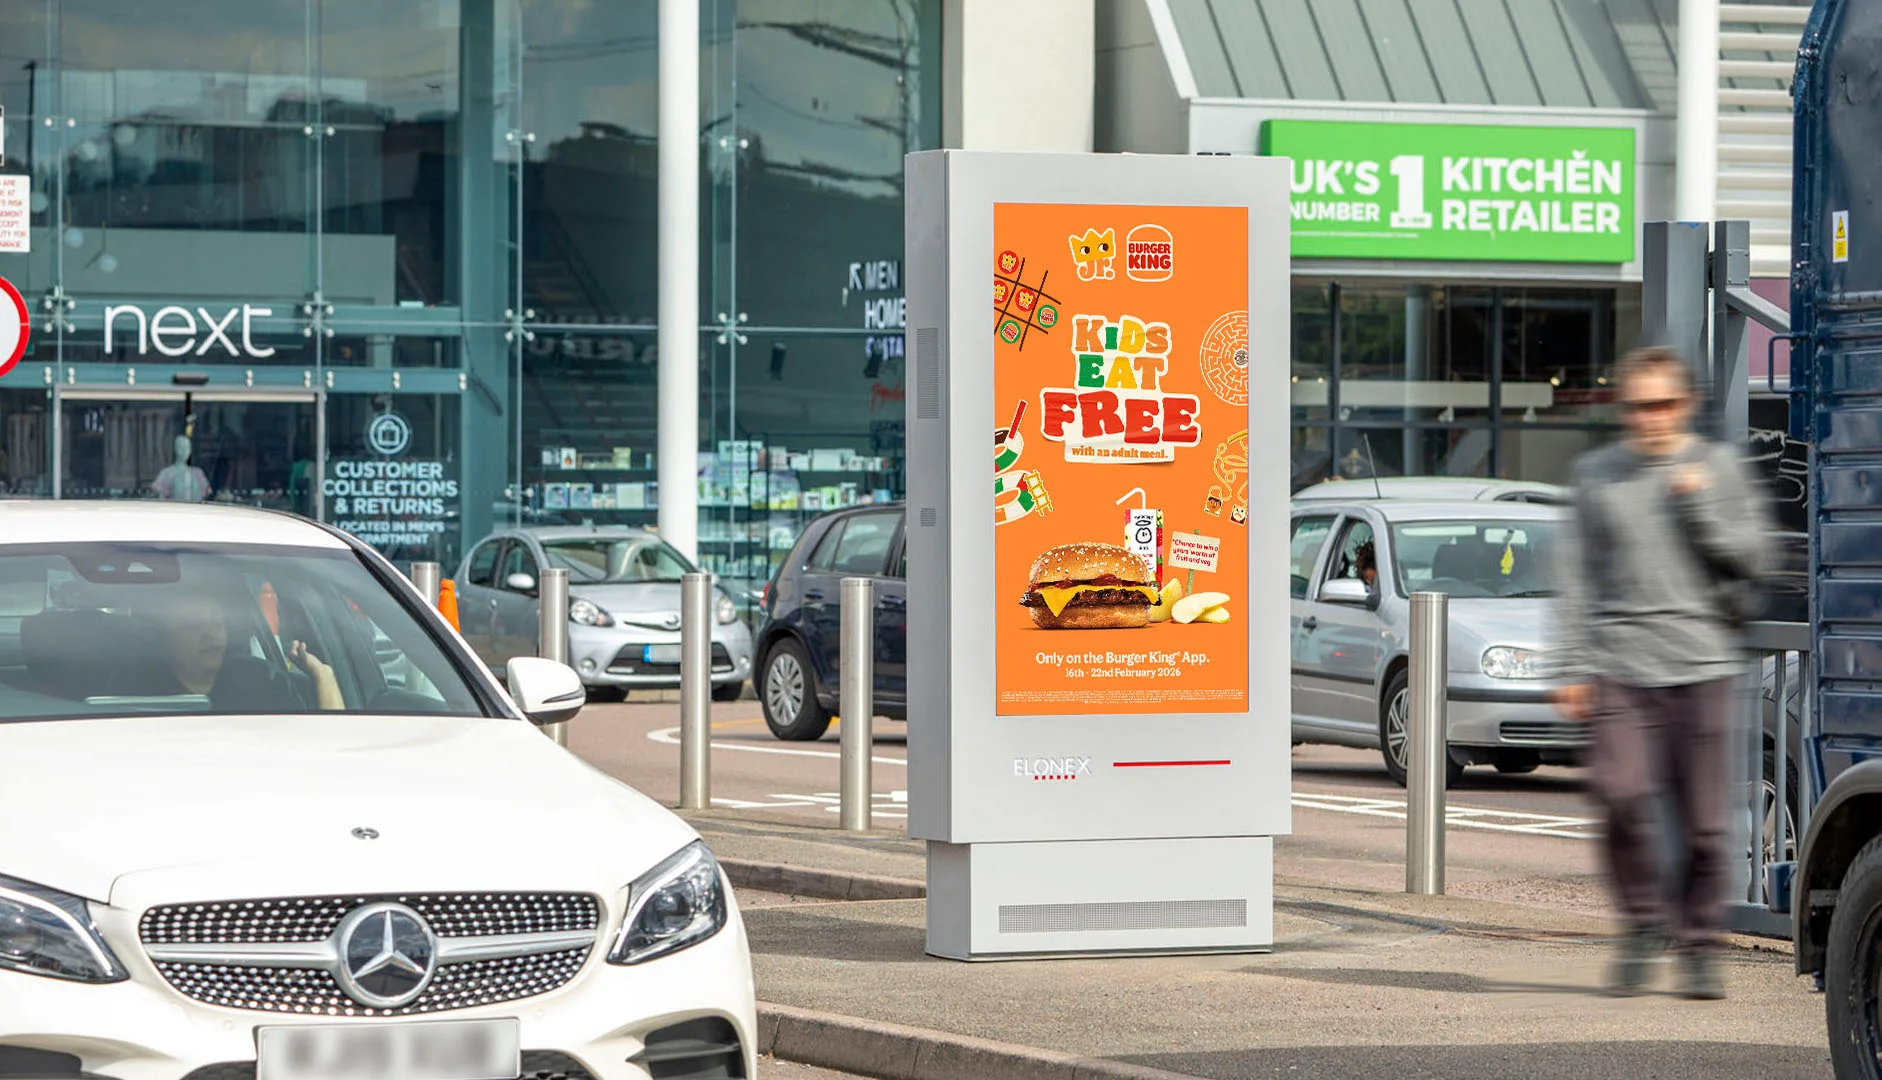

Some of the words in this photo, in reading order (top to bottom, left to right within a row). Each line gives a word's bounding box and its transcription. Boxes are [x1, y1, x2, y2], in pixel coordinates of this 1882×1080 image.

[1290, 159, 1380, 195] UK'S
[1389, 155, 1433, 228] 1
[1290, 201, 1380, 222] NUMBER
[1442, 199, 1621, 234] RETAILER
[1128, 243, 1171, 254] BURGER
[1128, 254, 1171, 270] KING
[865, 260, 898, 291] MEN
[864, 298, 906, 329] HOME
[104, 303, 276, 358] next
[865, 336, 905, 361] CSTA
[1078, 354, 1165, 390] EAT
[1043, 390, 1199, 444] FREE
[1071, 445, 1095, 457] with
[1097, 448, 1110, 457] an
[1111, 447, 1139, 458] adult
[1140, 448, 1169, 459] meal.
[335, 461, 443, 479] CUSTOMER
[322, 479, 459, 497] COLLECTIONS
[334, 498, 349, 514] &
[353, 498, 445, 515] RETURNS
[392, 521, 406, 532] IN
[1035, 651, 1064, 667] Only
[1066, 654, 1081, 664] on
[1083, 651, 1104, 664] the
[1105, 651, 1147, 667] Burger
[1181, 651, 1210, 666] App.
[1065, 667, 1085, 678] 16th
[1091, 668, 1114, 678] 22nd
[1114, 668, 1156, 679] February
[1157, 667, 1182, 678] 2026
[1013, 757, 1093, 777] ELONEX
